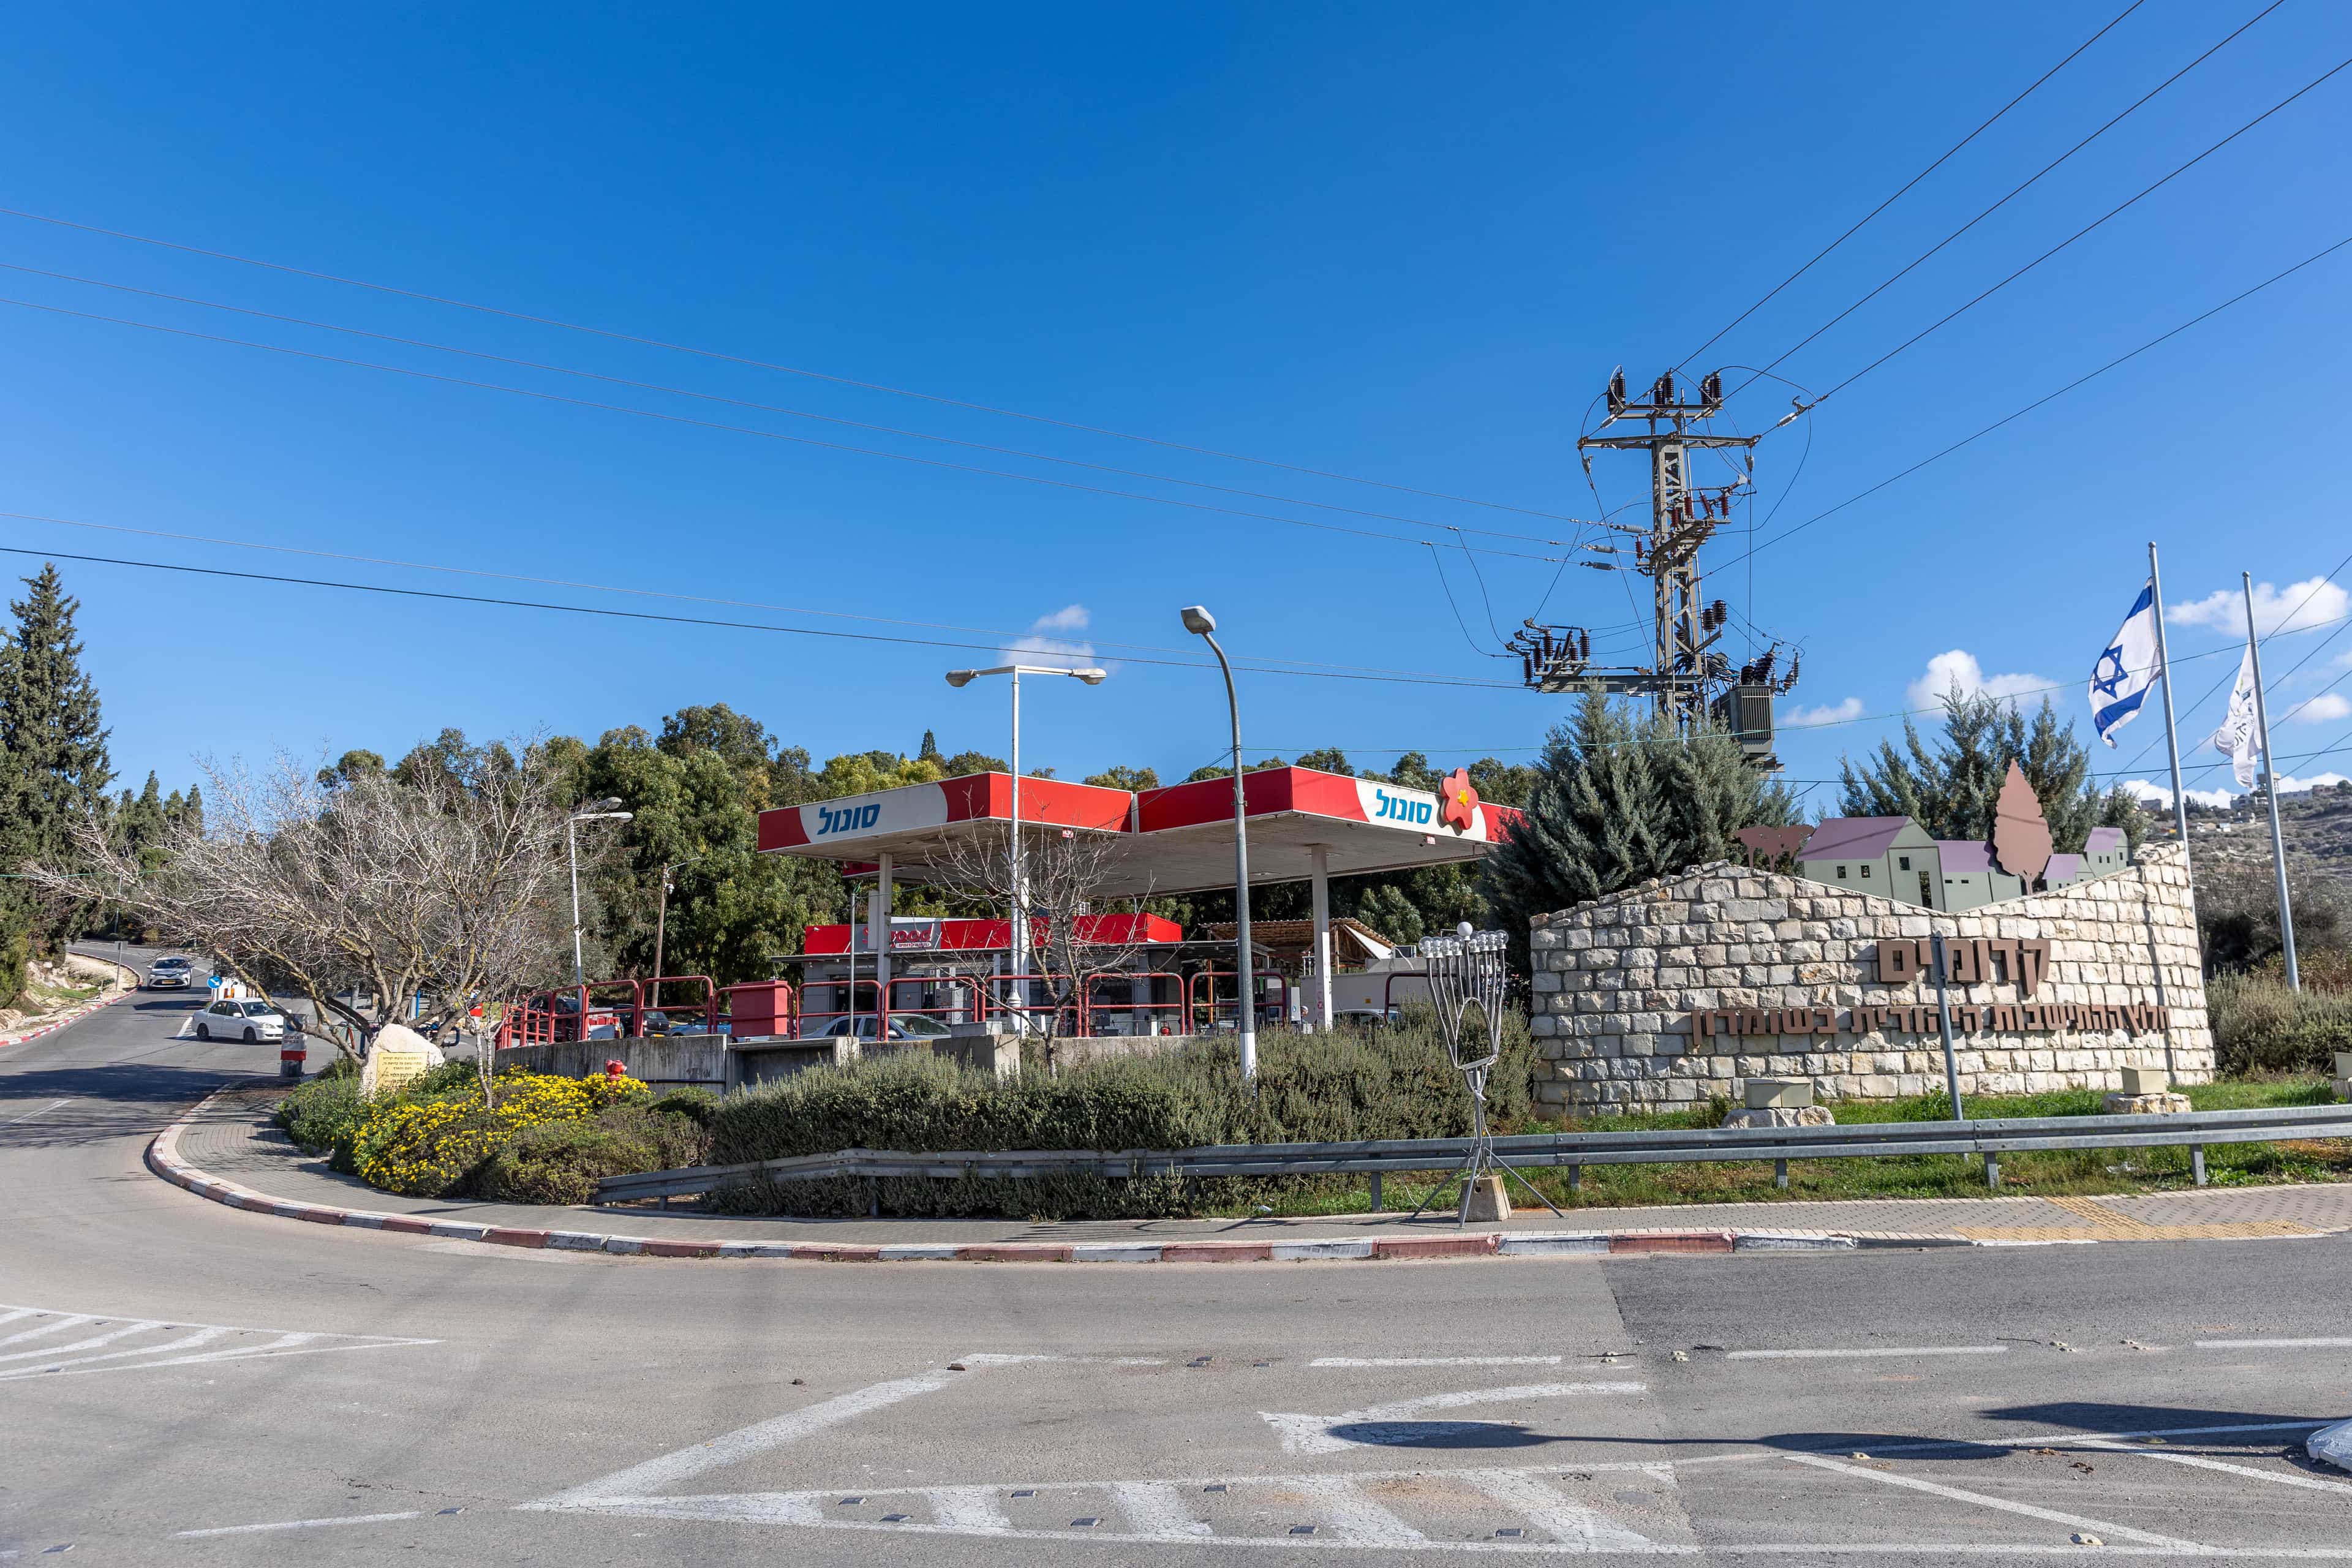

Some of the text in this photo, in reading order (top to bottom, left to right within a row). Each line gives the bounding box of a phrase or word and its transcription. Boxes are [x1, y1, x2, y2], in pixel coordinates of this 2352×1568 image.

[817, 804, 880, 835] סונול
[1376, 789, 1432, 824] סונול
[1877, 940, 2051, 995] קדומים
[1691, 1008, 1838, 1046] בשומרון
